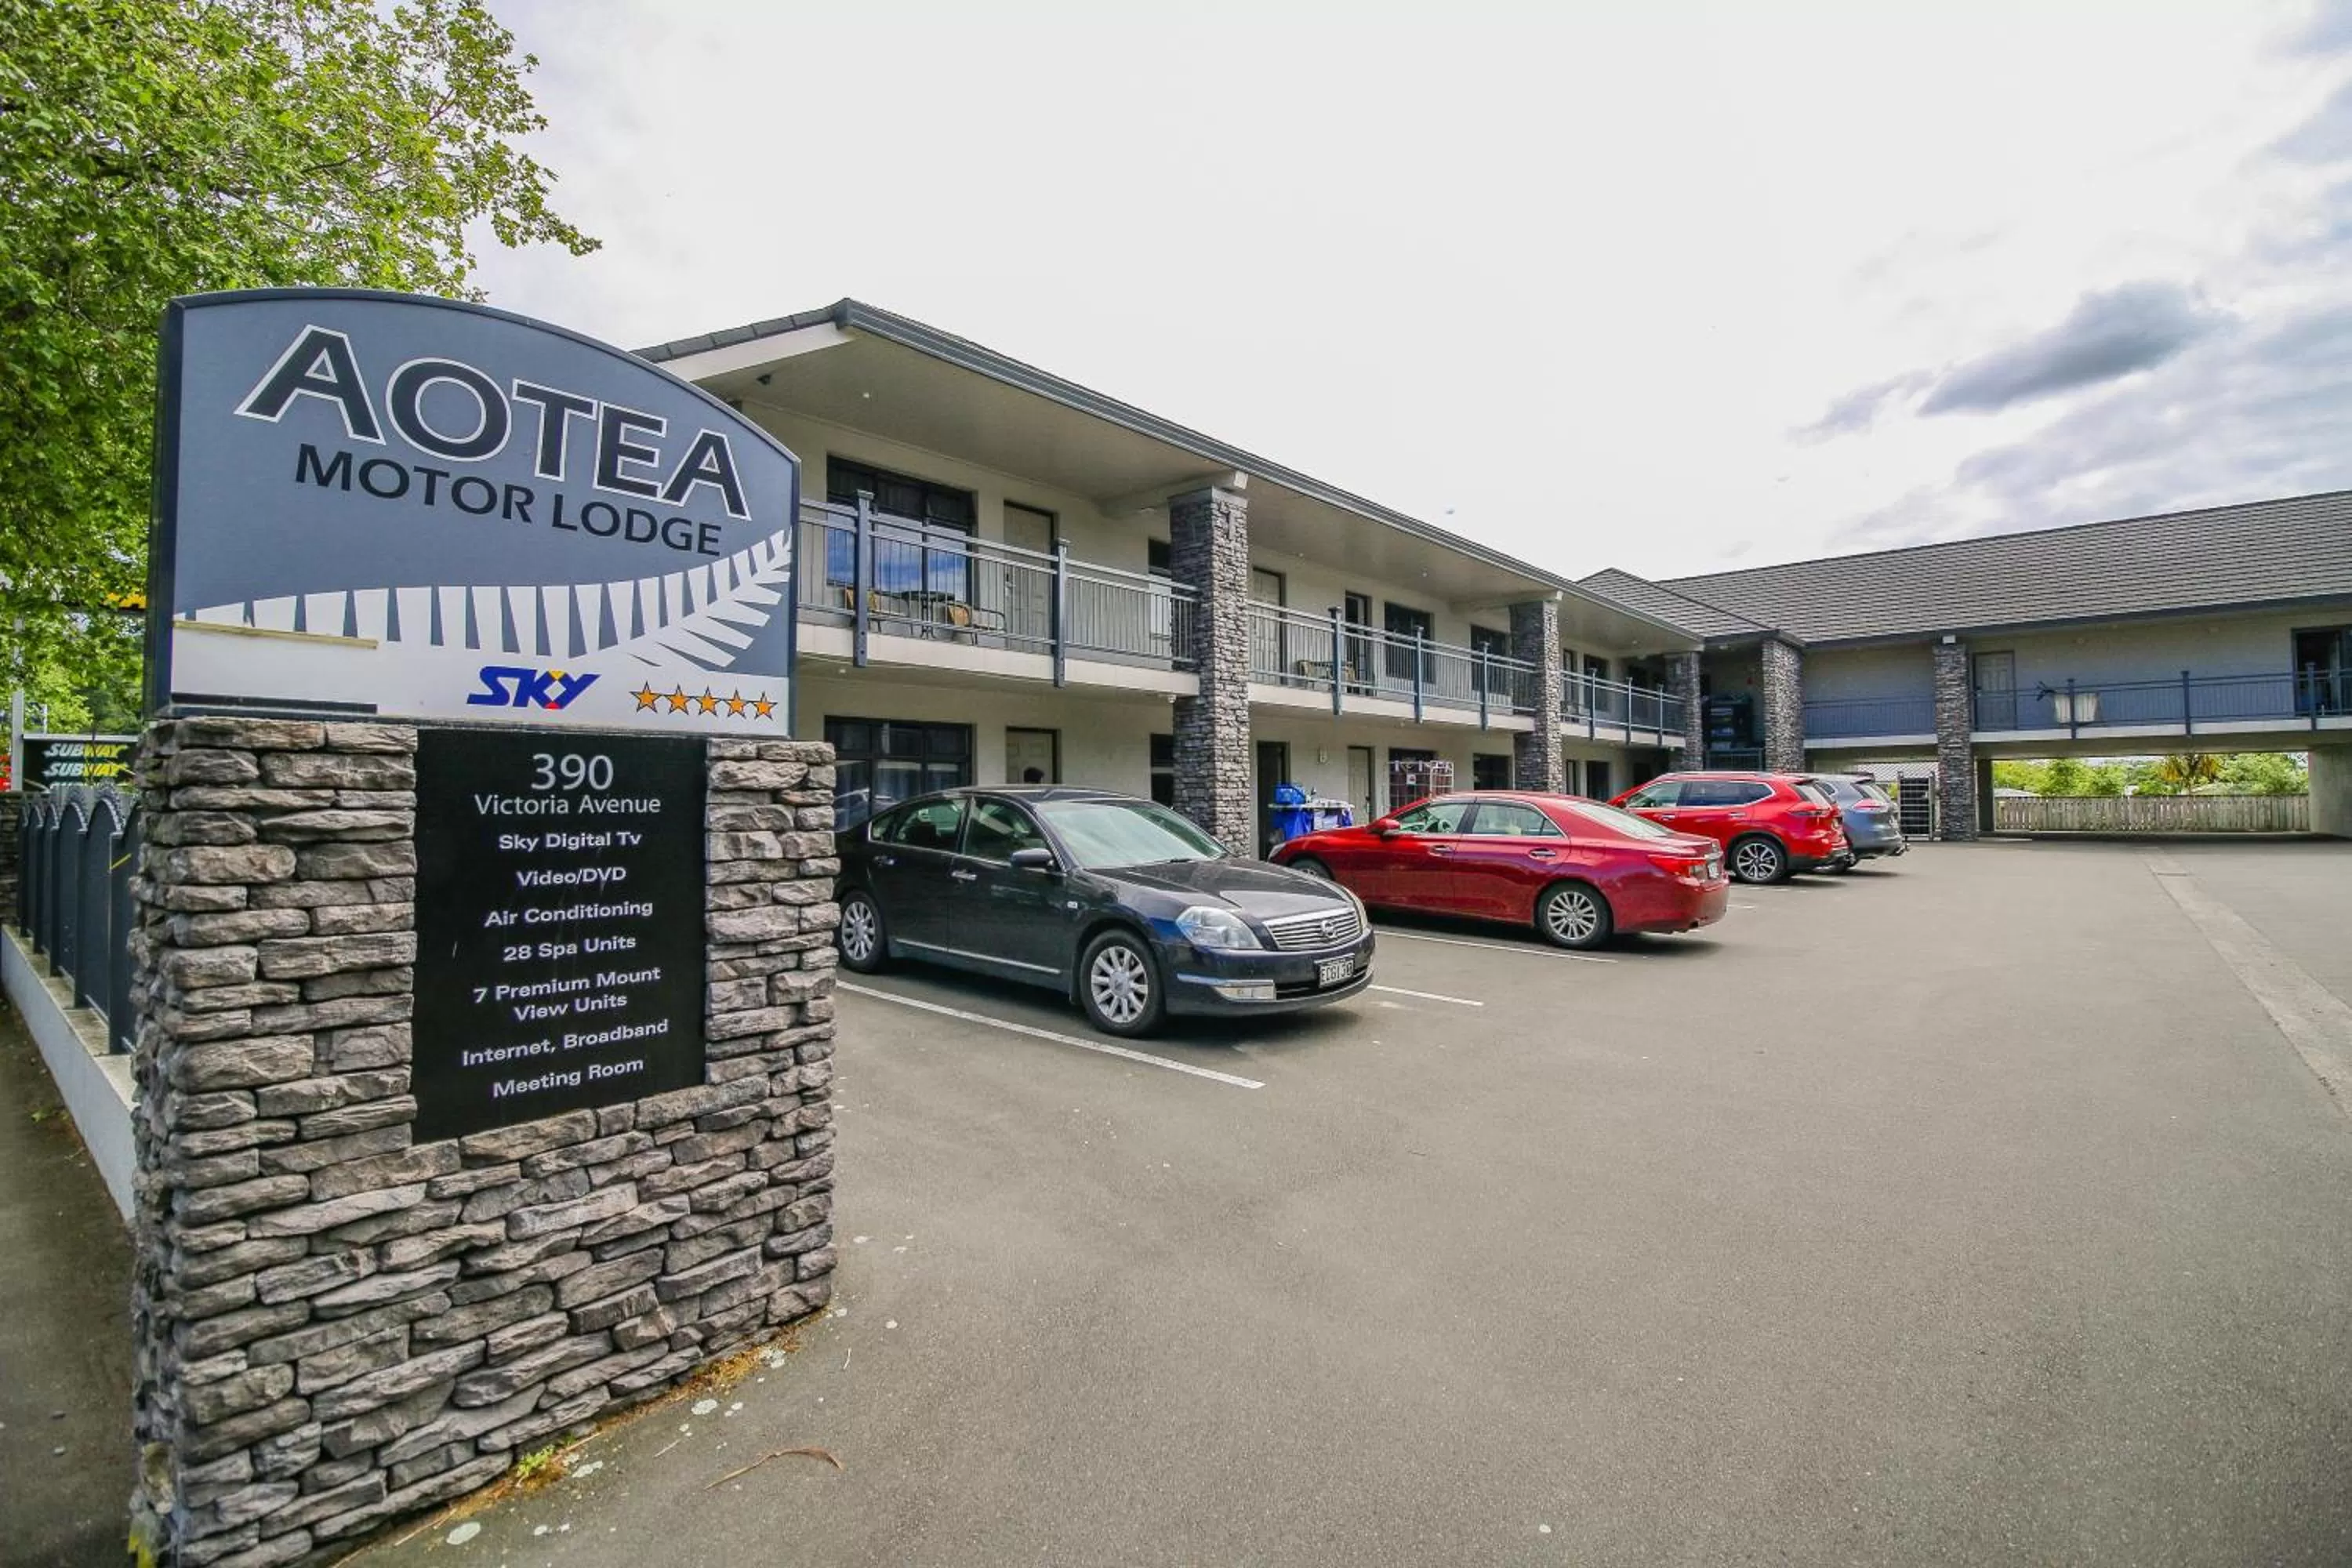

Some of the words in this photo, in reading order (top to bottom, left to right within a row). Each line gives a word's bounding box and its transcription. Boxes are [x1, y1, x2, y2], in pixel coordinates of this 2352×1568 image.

[234, 324, 751, 521] AOTEA
[295, 443, 535, 523] MOTOR
[552, 493, 722, 556] LODGE
[466, 666, 601, 710] SKY
[42, 742, 128, 757] SUBWAY
[42, 762, 129, 777] SUBWAY
[530, 753, 614, 791] 390
[474, 793, 569, 816] Victoria
[577, 794, 662, 815] Avenue
[499, 833, 539, 852] Sky
[546, 831, 612, 851] Digital
[616, 831, 642, 848] Tv
[516, 866, 627, 887] Video/DVD
[484, 909, 517, 927] Air
[524, 901, 654, 924] Conditioning
[503, 945, 532, 962] 28
[538, 942, 578, 961] Spa
[584, 935, 637, 953] Units
[473, 987, 488, 1004] 7
[495, 976, 590, 1001] Premium
[596, 966, 662, 989] Mount
[514, 1000, 568, 1022] View
[575, 994, 628, 1014] Units
[462, 1038, 557, 1067] Internet,
[563, 1018, 669, 1050] Broadband
[492, 1069, 582, 1098] Meeting
[588, 1058, 644, 1080] Room
